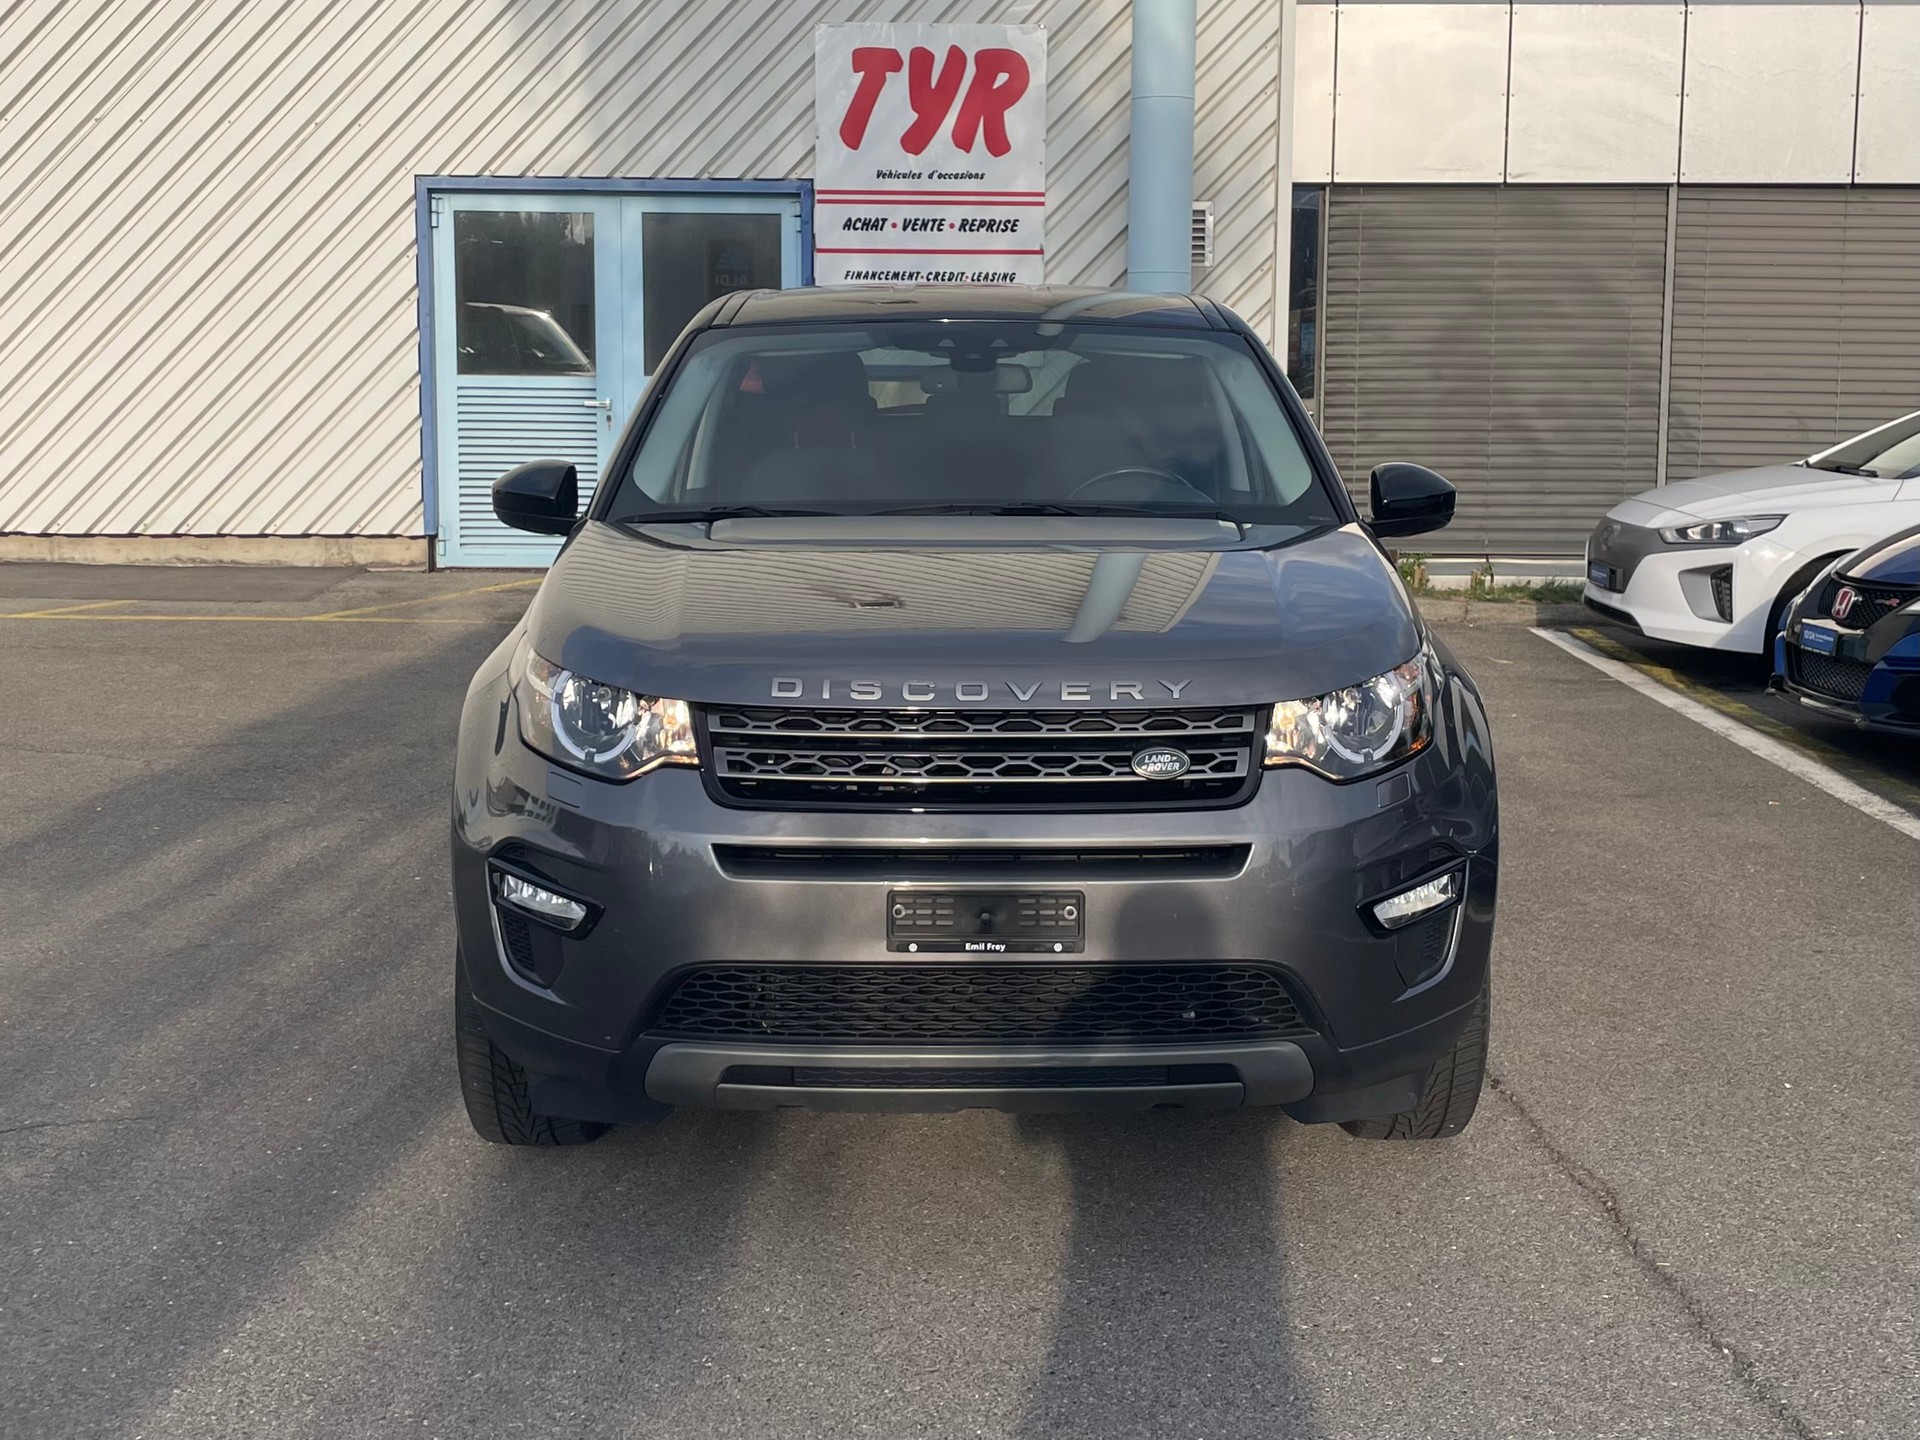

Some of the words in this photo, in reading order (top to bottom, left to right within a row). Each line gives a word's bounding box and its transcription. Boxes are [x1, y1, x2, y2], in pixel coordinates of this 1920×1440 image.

[839, 44, 1030, 158] TYR
[876, 169, 922, 180] Véhicules
[928, 169, 986, 180] d'occasions
[842, 216, 889, 232] ACHAT
[902, 217, 946, 232] VENTE
[958, 218, 1020, 233] REPRISE
[844, 270, 921, 281] FINANCEMENT
[926, 271, 966, 282] CREDIT
[971, 272, 1016, 283] LEASING
[771, 677, 1193, 701] DISCOVERY
[1145, 754, 1171, 763] LAND
[1147, 762, 1180, 772] ROVER
[965, 942, 985, 951] Emil
[986, 942, 1006, 952] Frey
